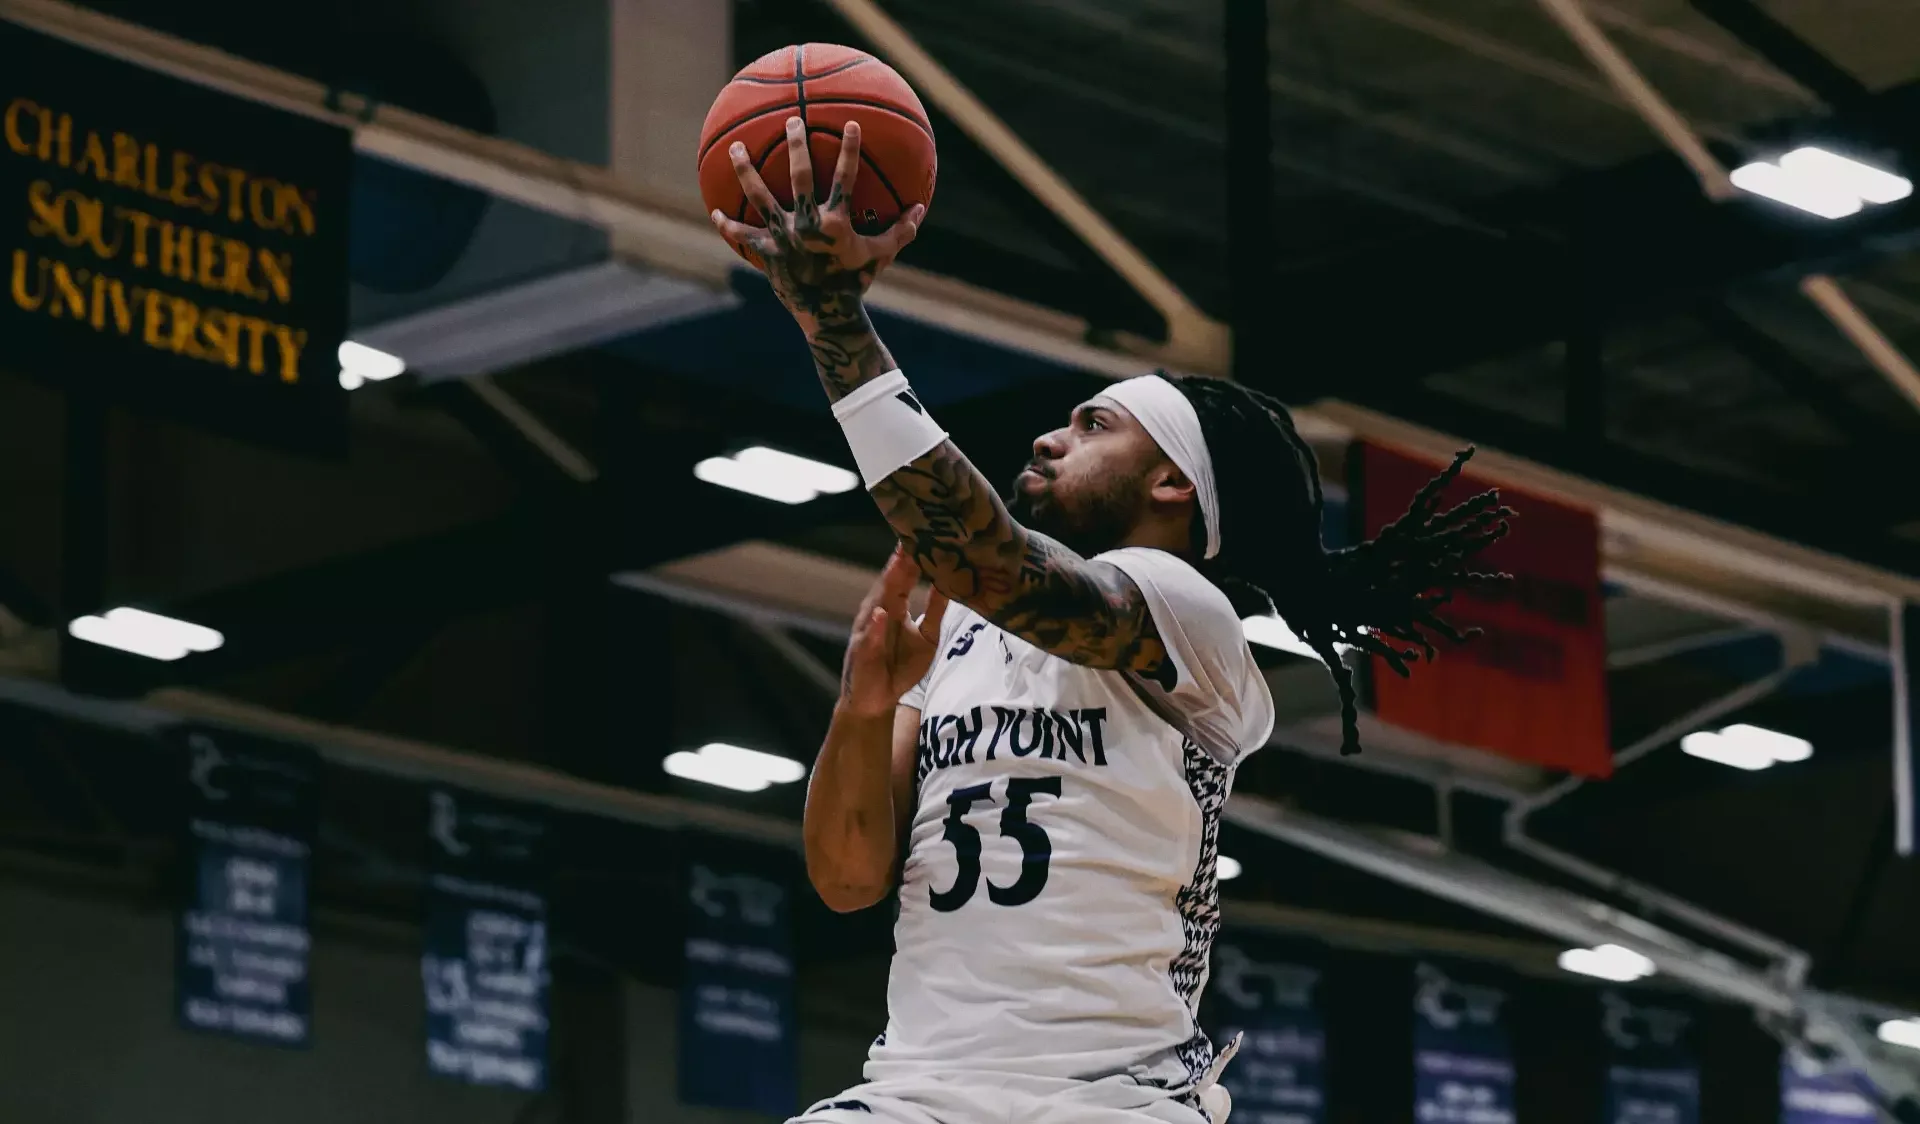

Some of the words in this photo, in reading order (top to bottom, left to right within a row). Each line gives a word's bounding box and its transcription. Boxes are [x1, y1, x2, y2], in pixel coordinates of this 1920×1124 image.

[4, 97, 317, 236] CHARLESTON
[27, 179, 292, 304] SOUTHERN
[11, 248, 308, 384] UNIVERSITY
[987, 707, 1108, 765] POINT
[929, 776, 1062, 912] 55
